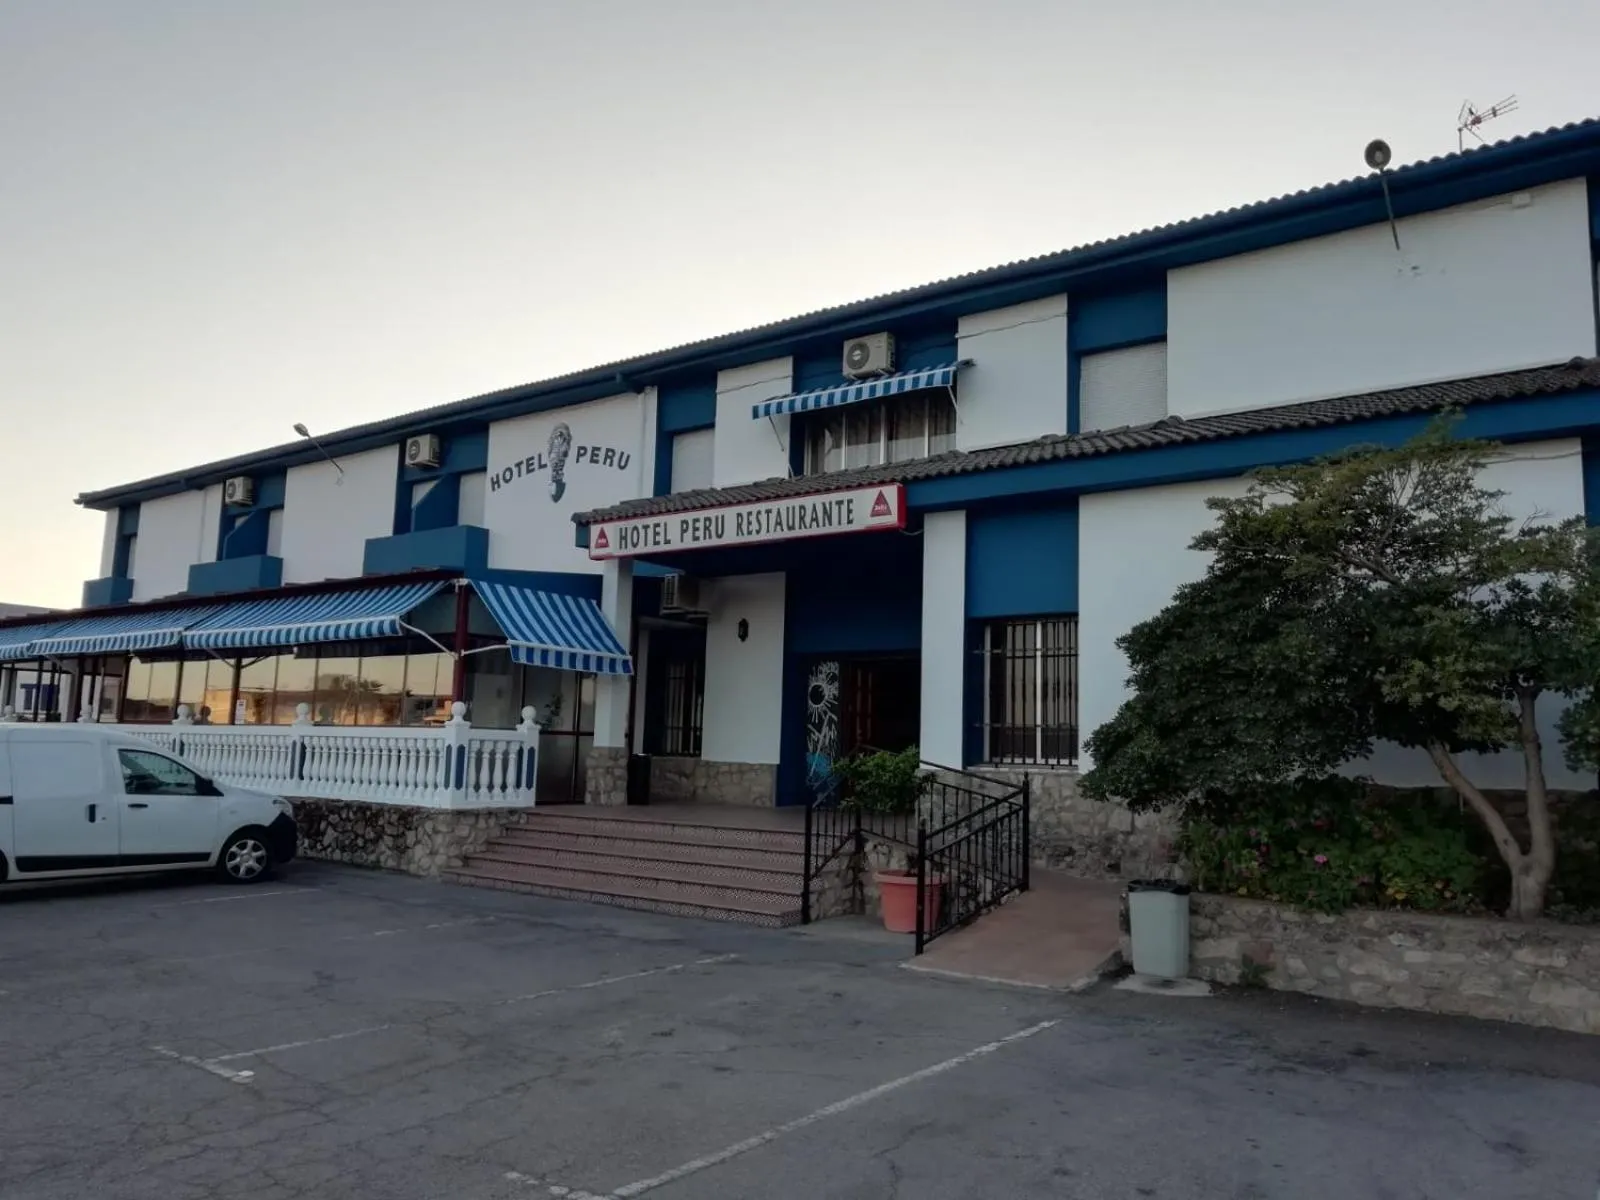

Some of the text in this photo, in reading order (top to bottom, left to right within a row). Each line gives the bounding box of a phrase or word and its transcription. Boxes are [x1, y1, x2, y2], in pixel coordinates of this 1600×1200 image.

[490, 445, 631, 492] HOTEL PERU
[618, 498, 854, 550] HOTEL PERU RESTAURANTE
